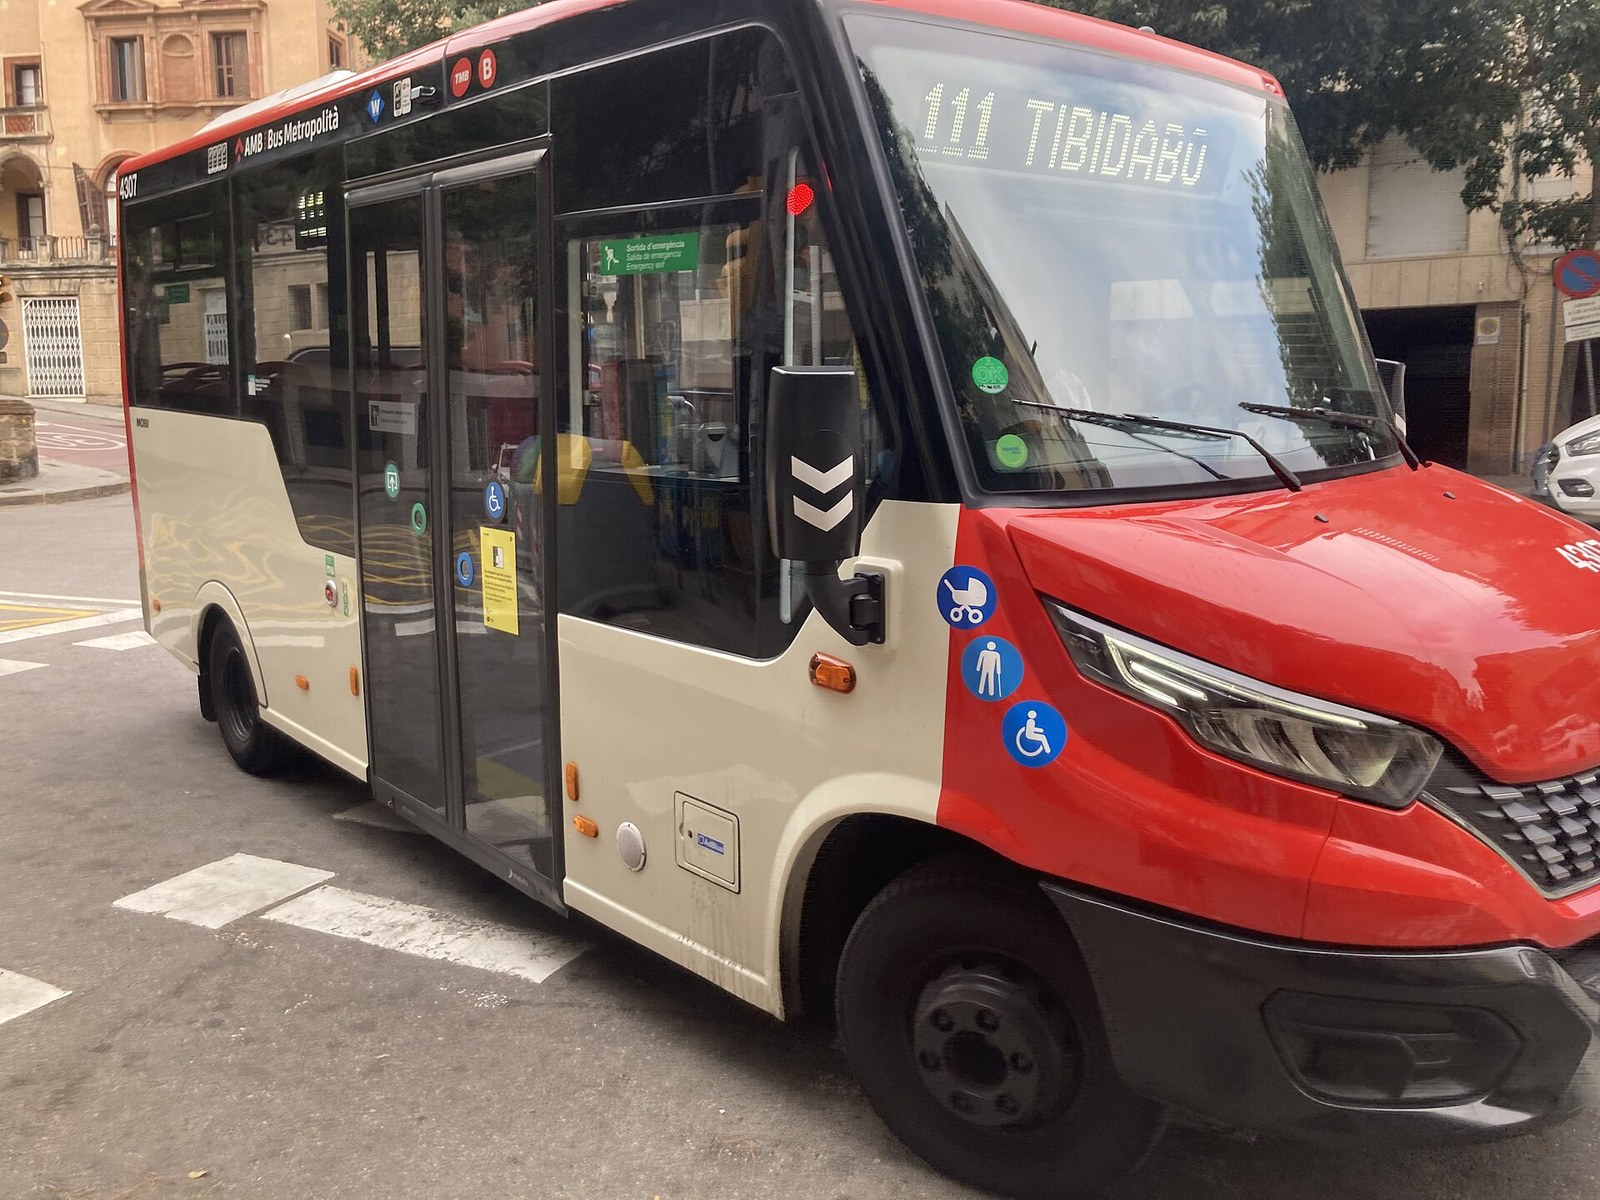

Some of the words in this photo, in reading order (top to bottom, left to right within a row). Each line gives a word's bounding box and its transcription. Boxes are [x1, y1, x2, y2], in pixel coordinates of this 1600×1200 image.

[454, 70, 470, 85] TMB
[482, 57, 493, 81] B
[370, 98, 381, 115] W
[244, 132, 264, 157] AMB
[267, 128, 283, 150] Bus
[283, 105, 339, 142] Metropolità
[915, 81, 995, 160] 111
[1024, 98, 1208, 186] TIBIDABO
[119, 173, 138, 200] 4307
[626, 244, 646, 252] Sortida
[643, 252, 650, 260] de
[626, 262, 654, 272] Emergency
[655, 260, 665, 269] exit
[976, 365, 1005, 384] OK
